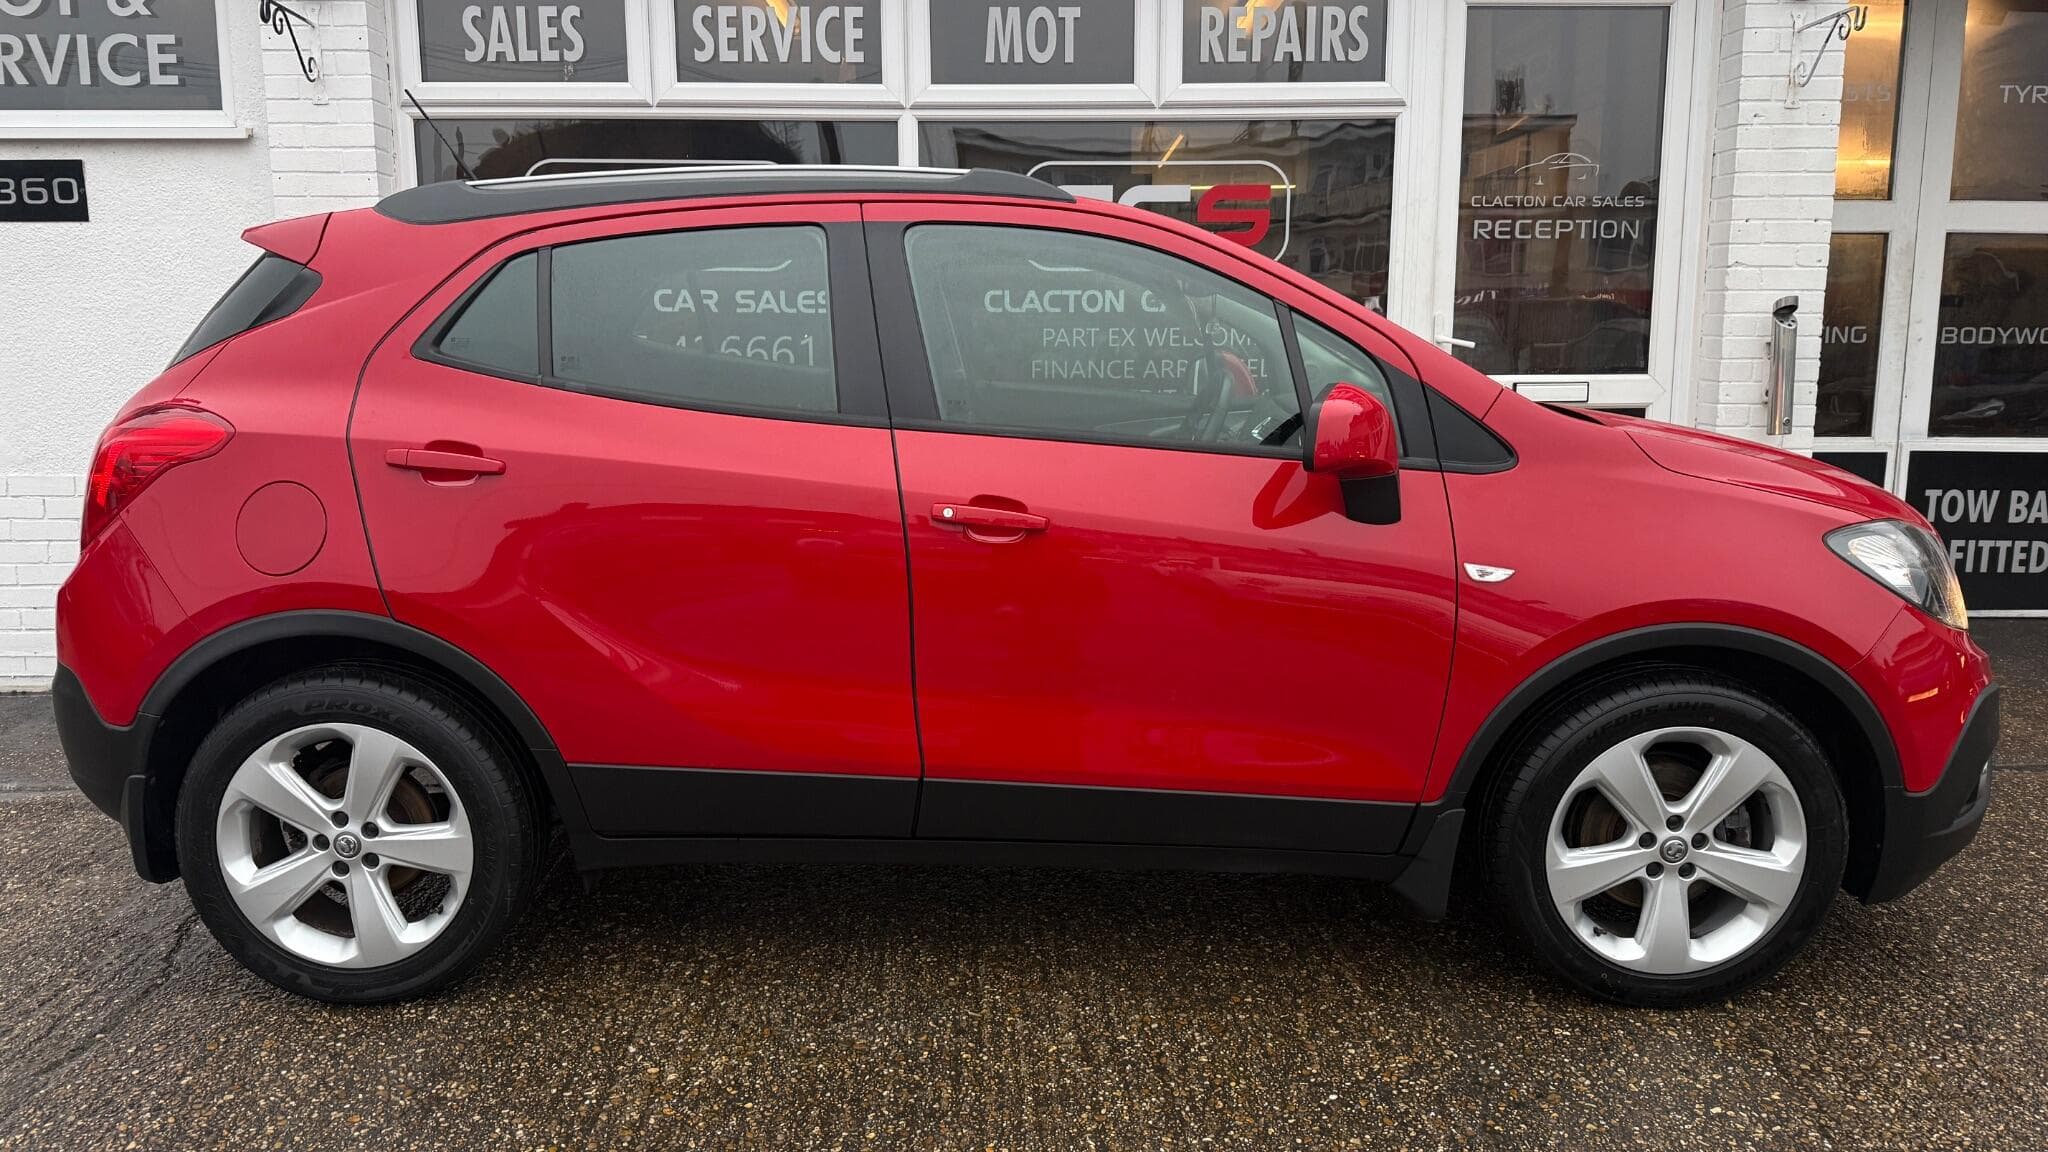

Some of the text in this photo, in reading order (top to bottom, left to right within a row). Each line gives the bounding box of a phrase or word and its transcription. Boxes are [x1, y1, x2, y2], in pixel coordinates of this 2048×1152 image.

[462, 5, 584, 63] SALES
[692, 5, 865, 63] SERVICE
[985, 6, 1081, 64] MOT
[1200, 6, 1369, 63] REPAIRS
[0, 33, 179, 86] RVICE
[2000, 84, 2048, 104] TYR
[1471, 195, 1645, 207] CLACTON CAR SALES
[1473, 219, 1640, 240] RECEPTION
[653, 288, 719, 313] CAR
[984, 289, 1124, 313] CLACTON
[1043, 327, 1099, 348] PART
[1108, 327, 1136, 347] EX
[1823, 325, 1867, 344] ING
[1032, 359, 1135, 379] FINANCE
[1925, 489, 2048, 523] TOW BA
[1949, 539, 2048, 574] FITTED
